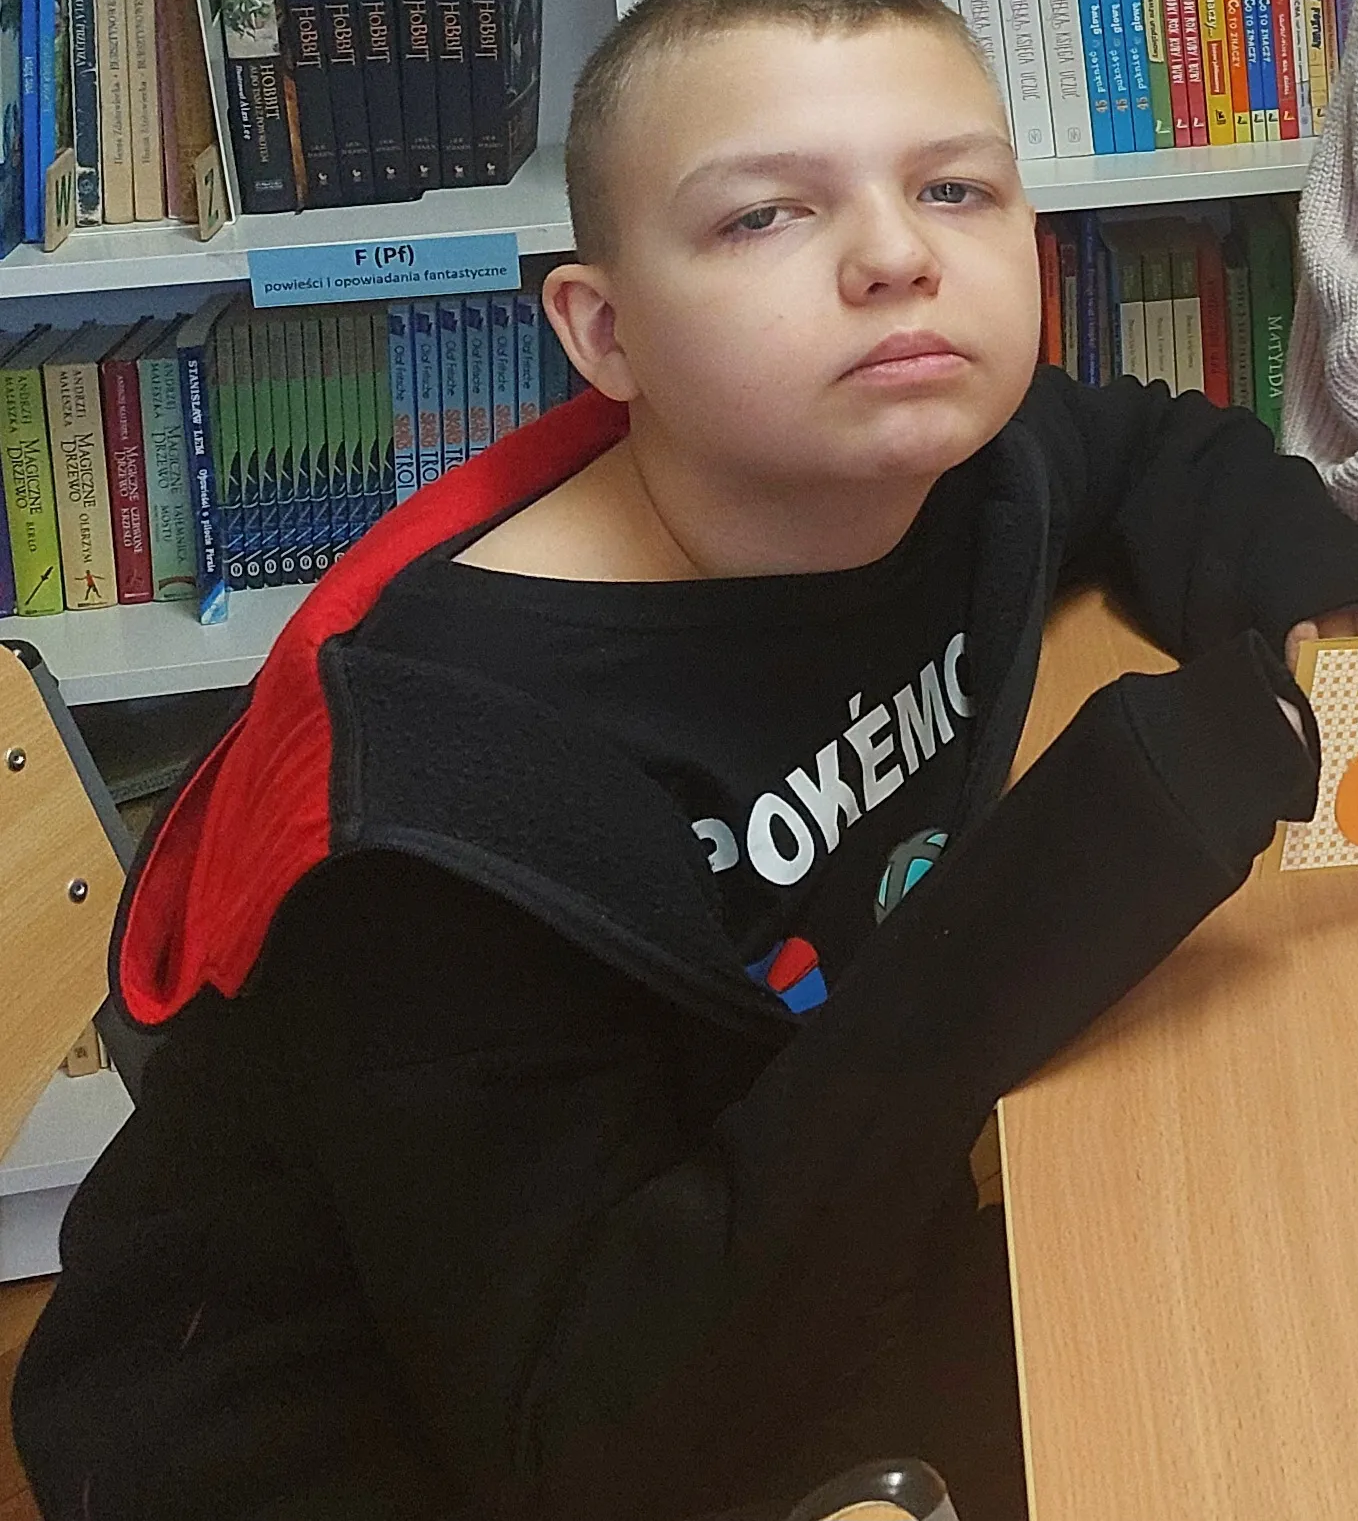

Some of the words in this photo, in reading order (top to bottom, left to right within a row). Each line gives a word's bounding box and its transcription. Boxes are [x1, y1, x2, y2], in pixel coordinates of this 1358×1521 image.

[1184, 17, 1197, 33] ROK
[1186, 37, 1199, 55] KUBY
[260, 63, 280, 121] HOBBIT
[264, 278, 325, 293] powieści
[334, 271, 420, 289] opowiadania
[423, 266, 508, 284] fantastyczne
[354, 249, 367, 266] F
[374, 245, 414, 268] (Pf)
[1267, 316, 1285, 399] MATYLDA
[60, 371, 73, 427] MALESZKA
[72, 370, 86, 419] ANDRZEJ
[188, 360, 202, 424] STANISŁAW
[74, 433, 96, 507] MAGICZNE
[151, 432, 170, 489] DRZEWO
[163, 425, 183, 494] MAGICZNE
[193, 430, 204, 455] LEM
[7, 446, 27, 509] DRZEWO
[20, 438, 42, 515] MAGICZNE
[61, 440, 81, 502] DRZEWO
[79, 513, 92, 564] OLBRZYM
[161, 506, 171, 542] MOSTU
